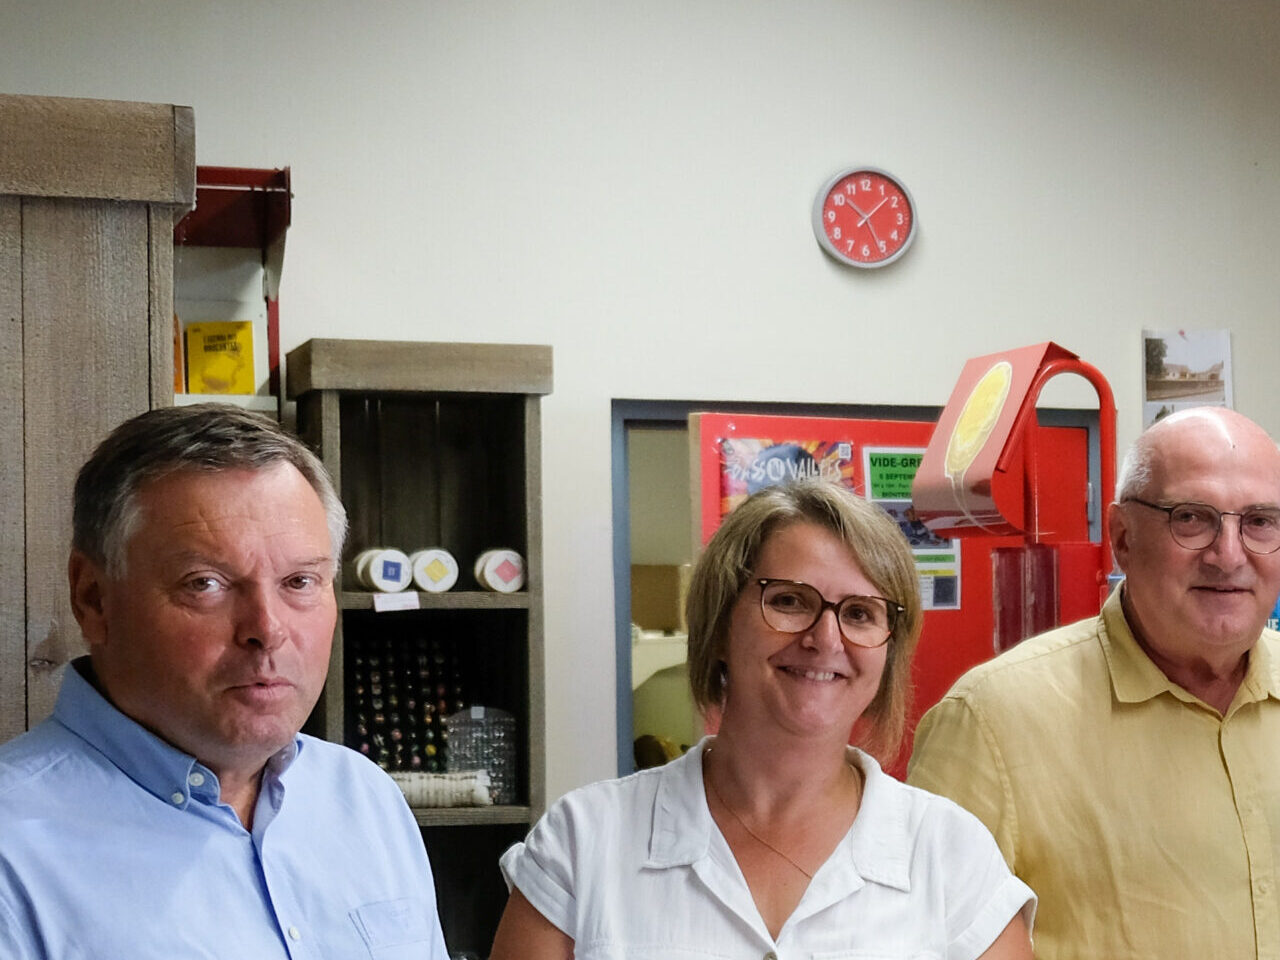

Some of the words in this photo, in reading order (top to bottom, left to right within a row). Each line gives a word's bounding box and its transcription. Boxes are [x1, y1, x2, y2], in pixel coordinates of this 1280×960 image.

[846, 183, 856, 195] 11
[860, 179, 872, 191] 12
[879, 184, 885, 196] 1
[833, 193, 845, 206] 10
[891, 196, 898, 208] 2
[828, 210, 836, 223] 9
[896, 212, 904, 225] 3
[833, 226, 841, 239] 8
[890, 229, 898, 241] 4
[847, 240, 855, 252] 7
[862, 245, 870, 257] 6
[879, 240, 886, 253] 5
